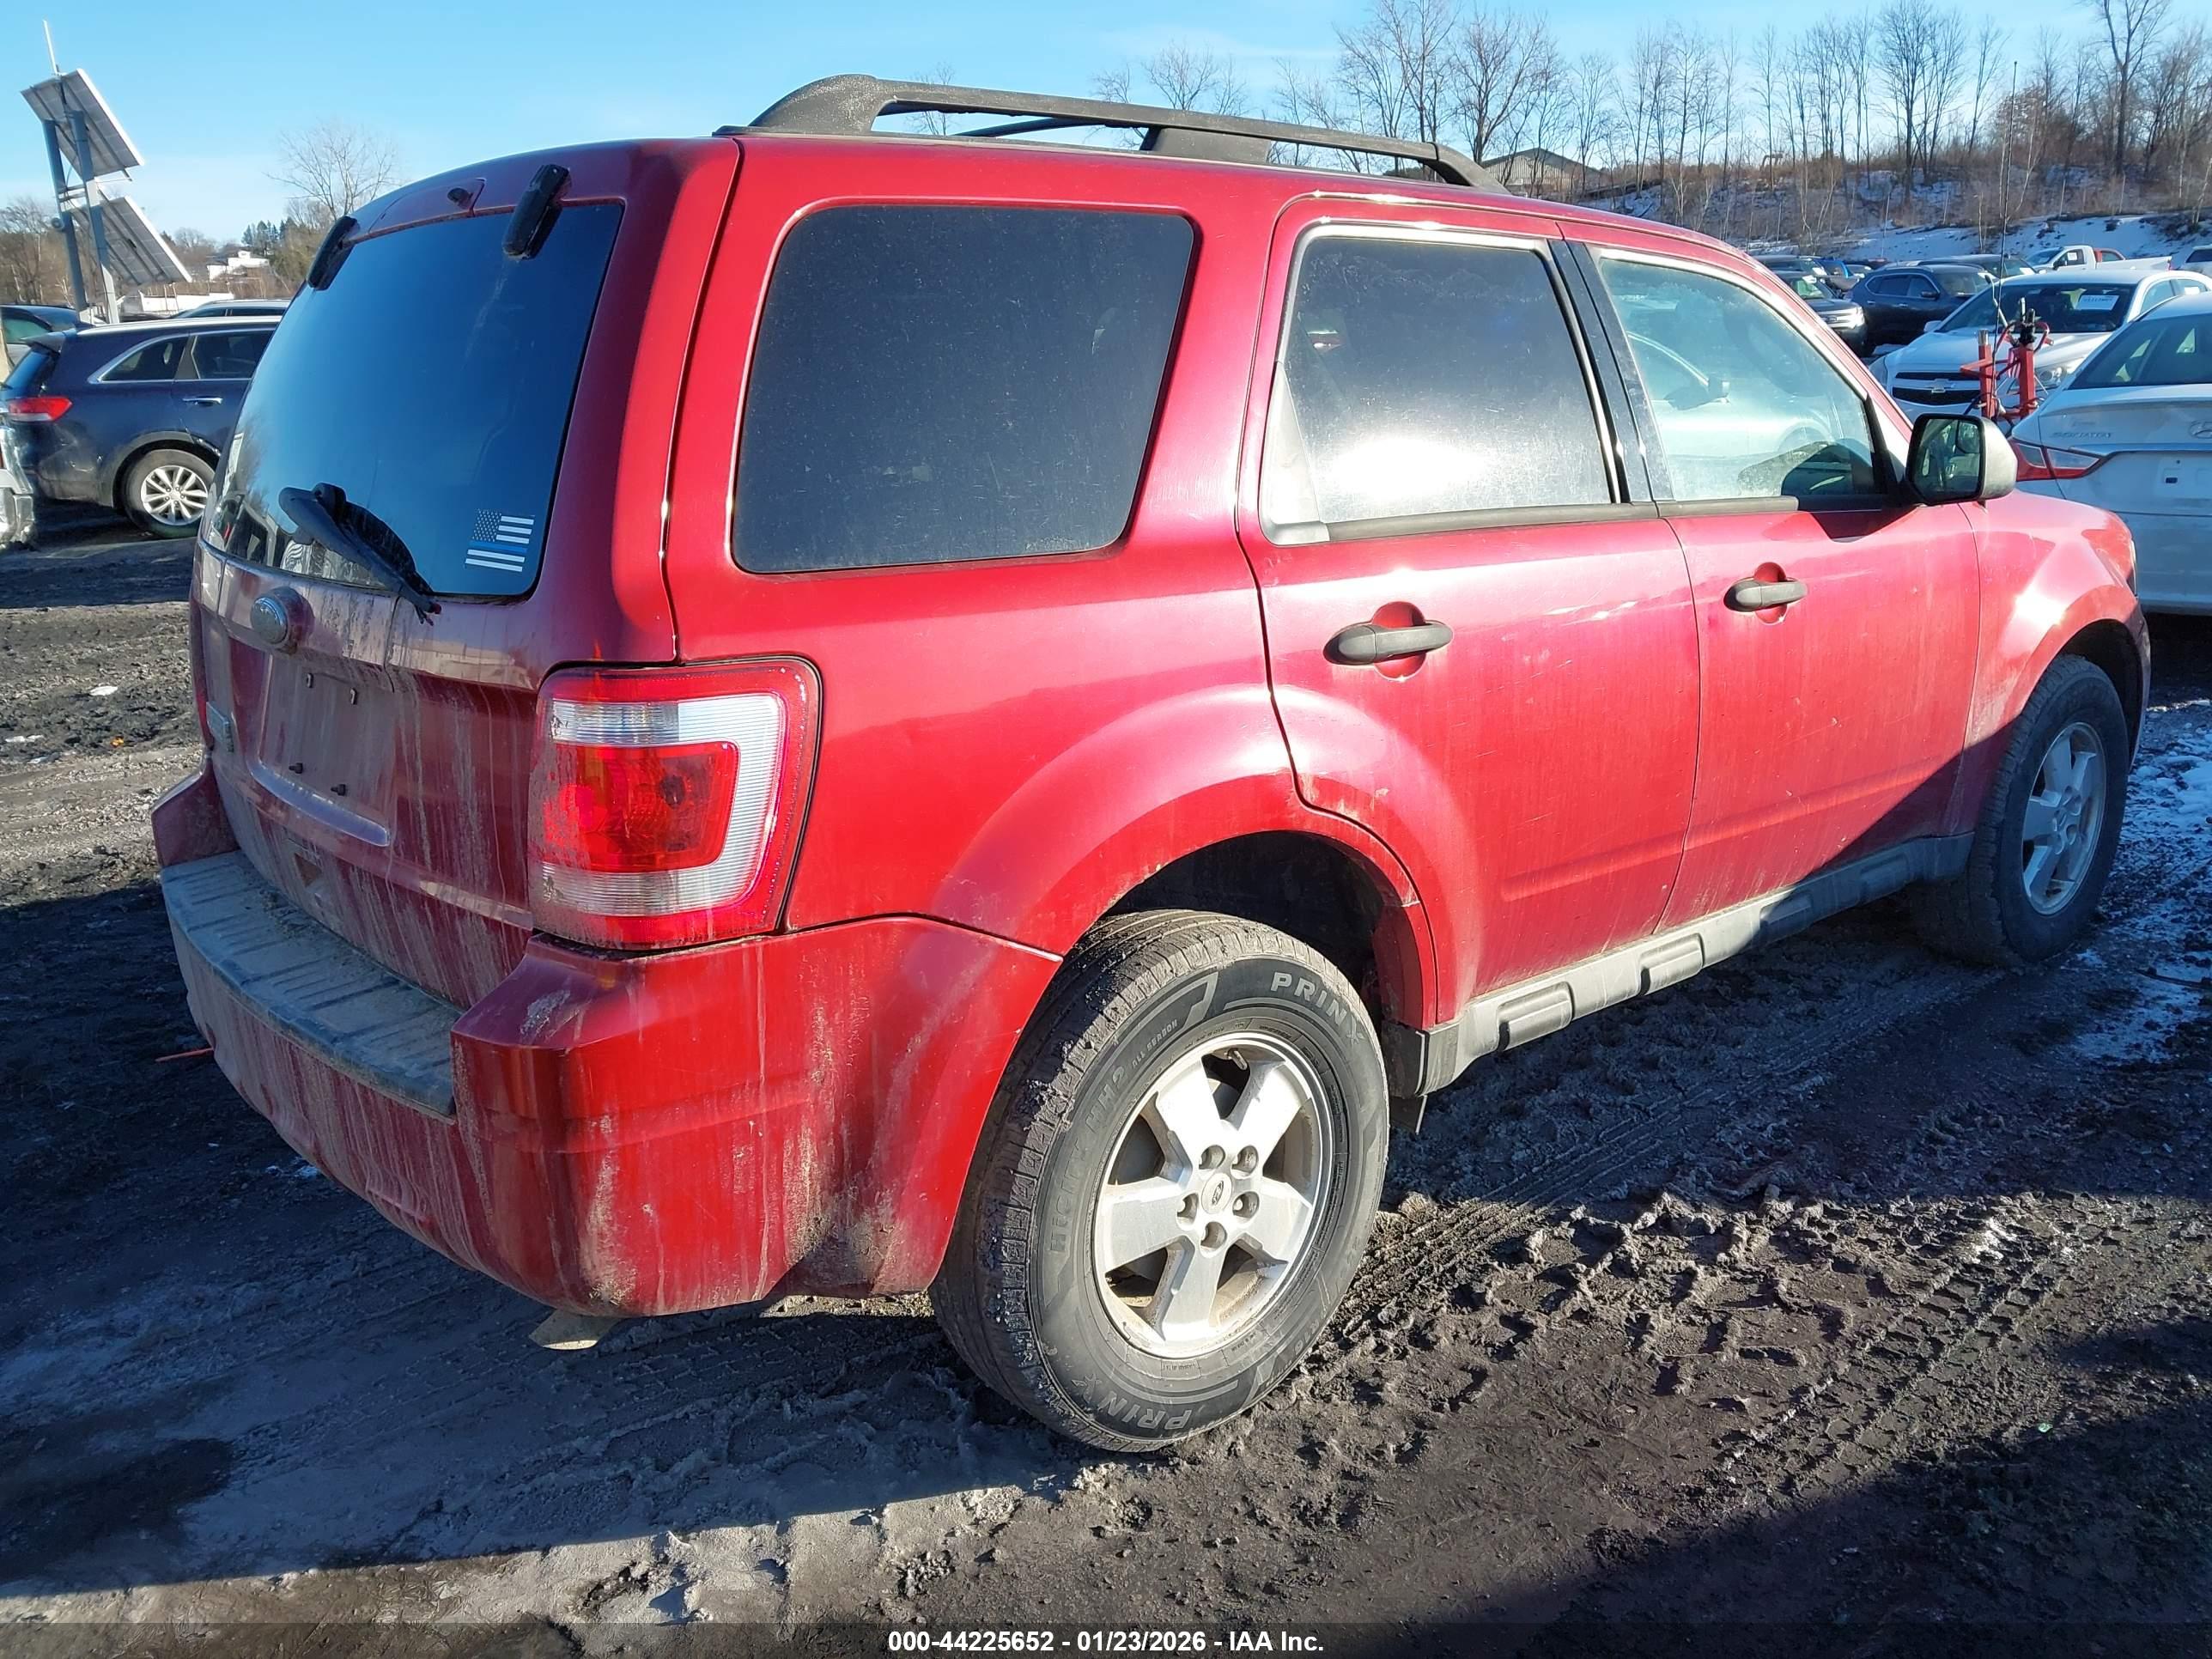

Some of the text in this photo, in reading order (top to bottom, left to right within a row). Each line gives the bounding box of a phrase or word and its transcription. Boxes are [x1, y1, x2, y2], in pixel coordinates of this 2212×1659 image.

[1146, 1018, 1177, 1052] SEASON
[1270, 971, 1365, 1044] PRINX
[1071, 1373, 1193, 1430] PRINX
